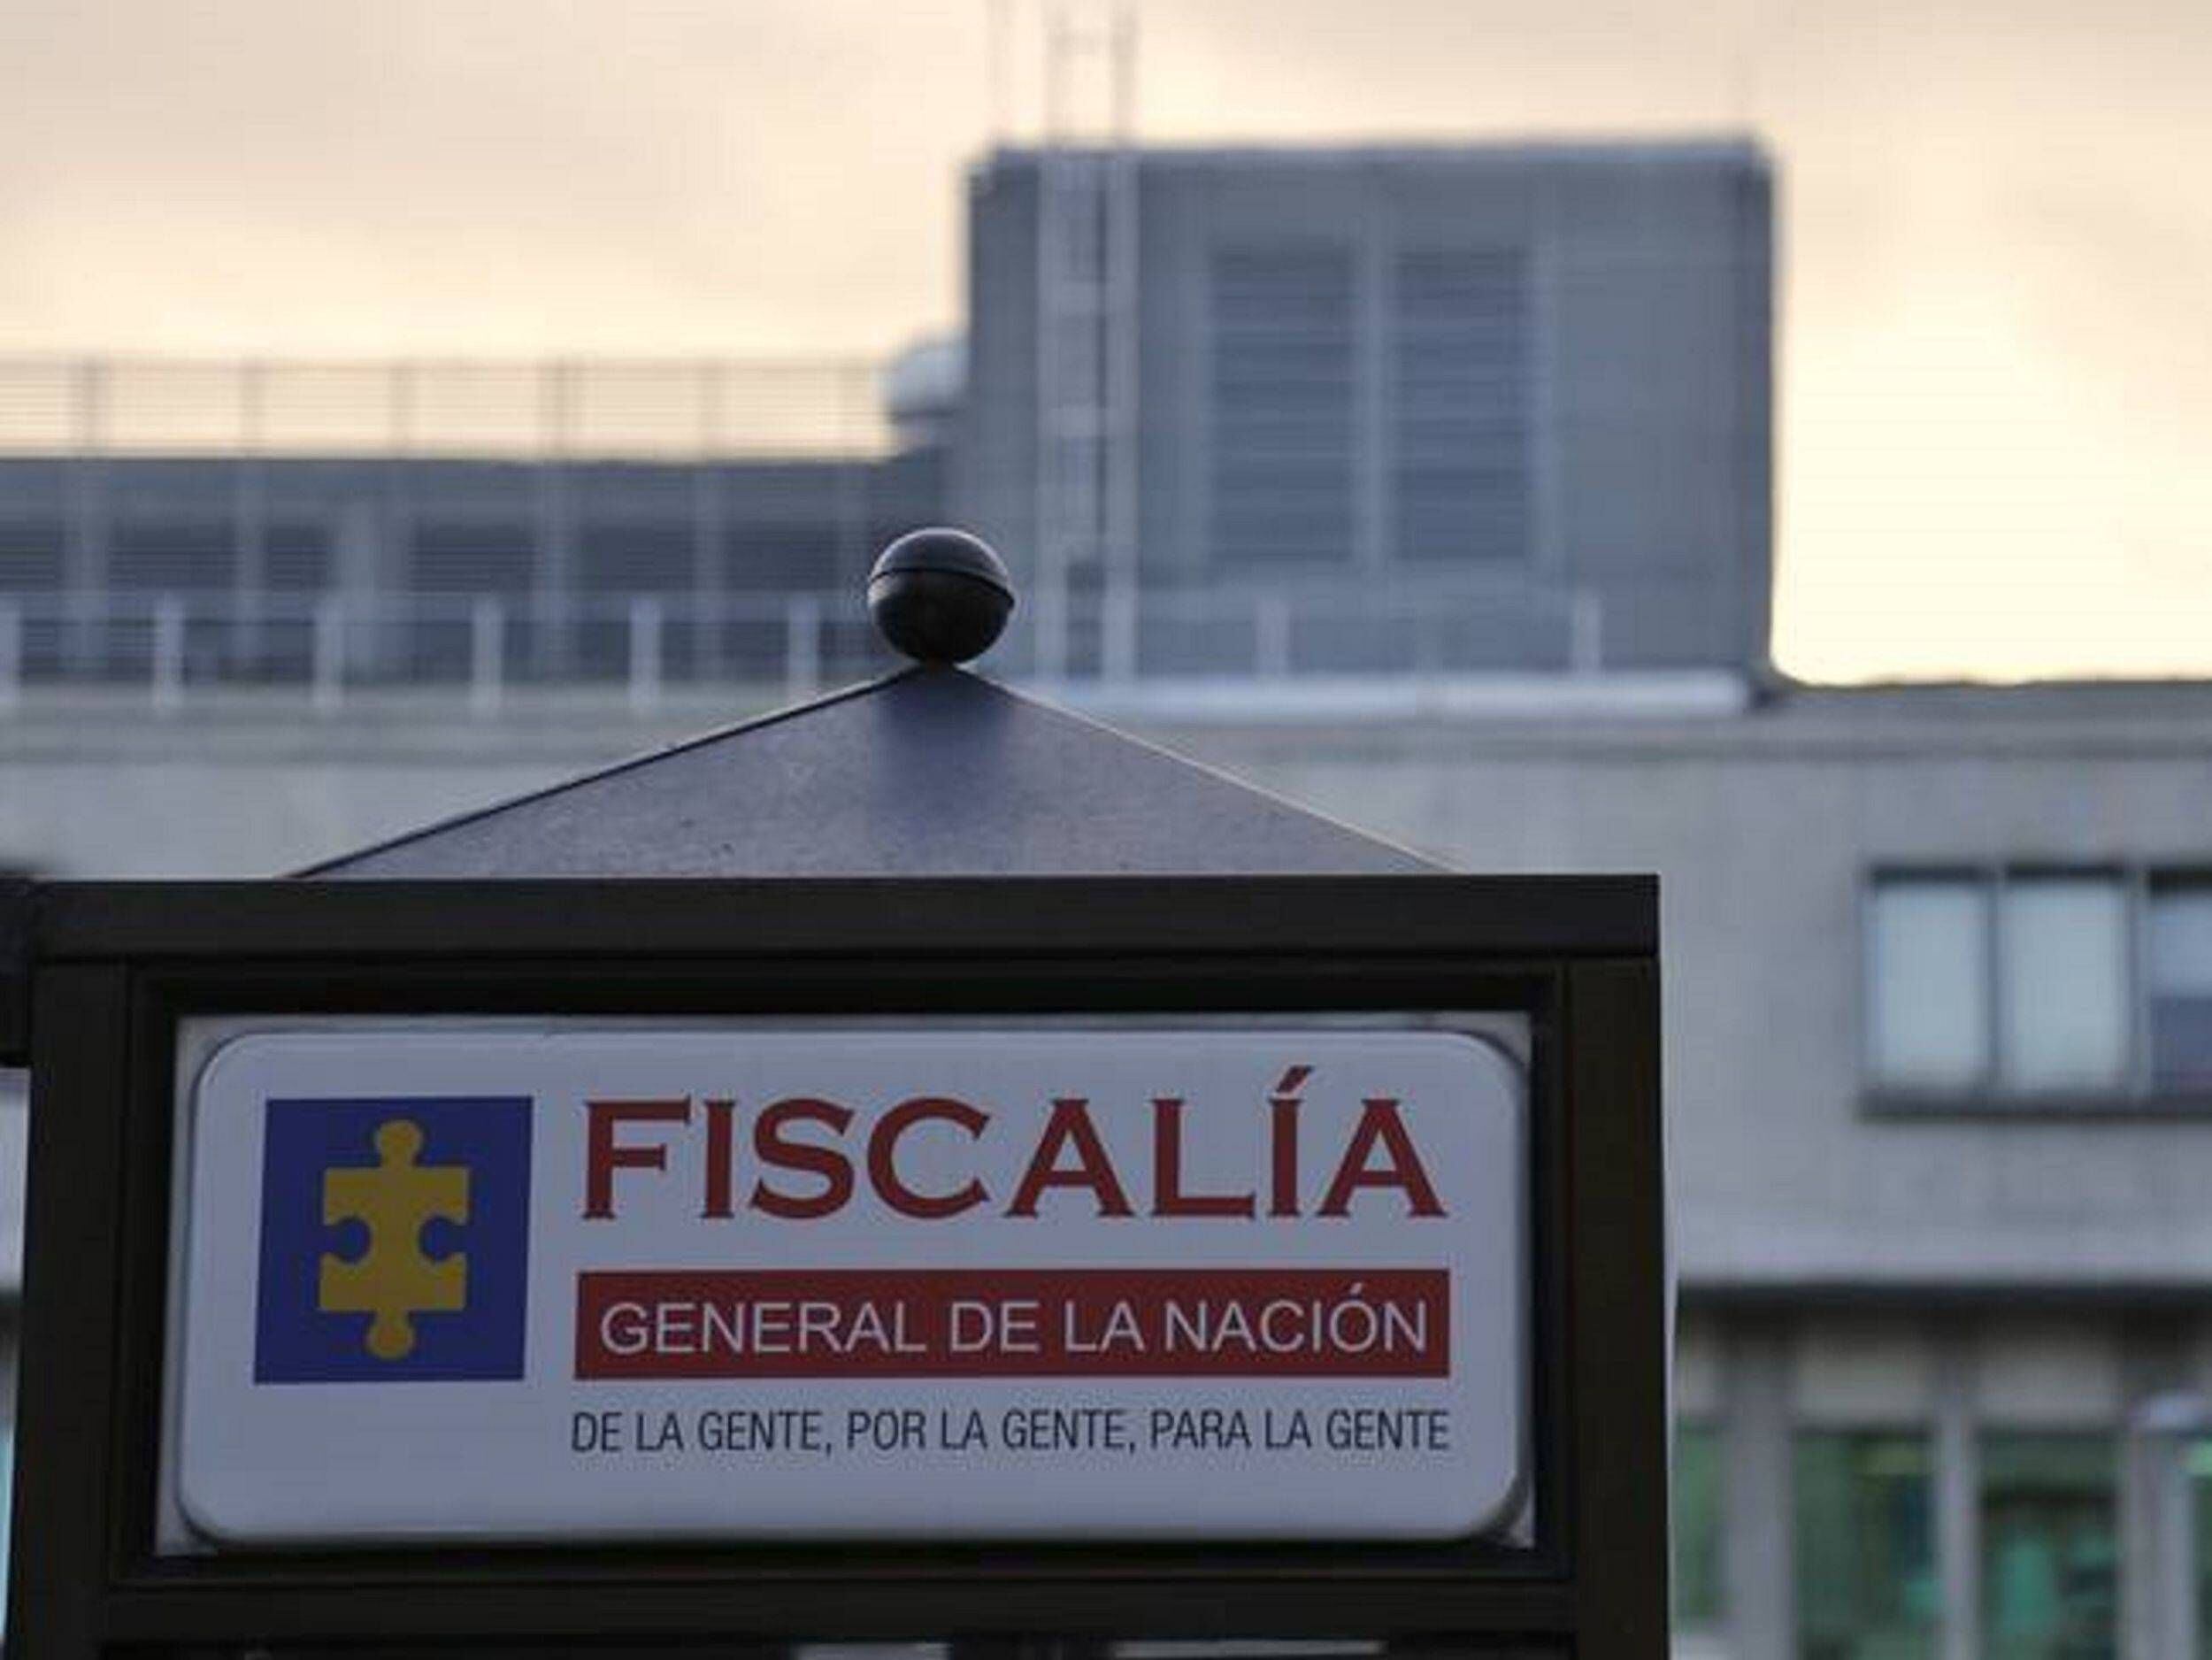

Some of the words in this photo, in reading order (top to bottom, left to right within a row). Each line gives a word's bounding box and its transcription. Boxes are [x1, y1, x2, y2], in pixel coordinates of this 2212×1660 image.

[581, 1065, 1449, 1220] FISCALÍA
[600, 1301, 926, 1355] GENERAL
[950, 1301, 1040, 1354] DE
[1064, 1301, 1144, 1353] LA
[1164, 1282, 1426, 1353] NACIÓN
[572, 1412, 623, 1452] DE
[635, 1412, 685, 1451] LA
[697, 1411, 833, 1457] GENTE,
[847, 1410, 929, 1451] POR
[941, 1410, 988, 1450] LA
[1002, 1410, 1138, 1456] GENTE,
[1150, 1409, 1251, 1450] PARA
[1263, 1409, 1314, 1449] LA
[1325, 1409, 1450, 1449] GENTE
